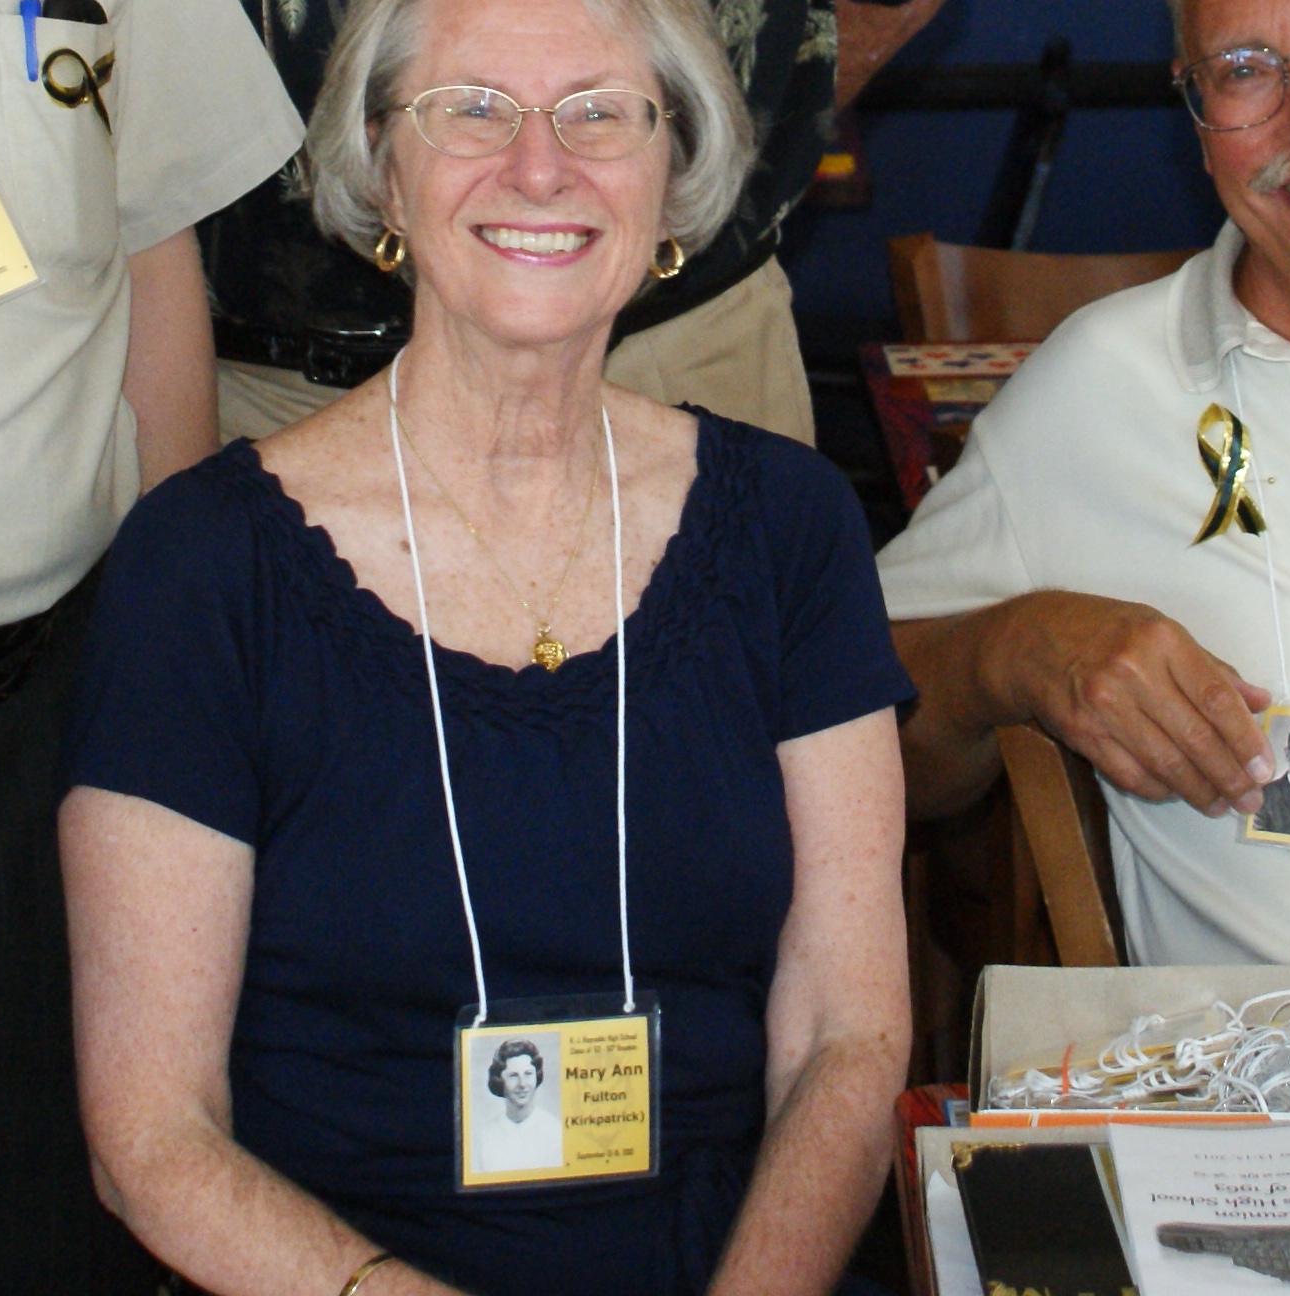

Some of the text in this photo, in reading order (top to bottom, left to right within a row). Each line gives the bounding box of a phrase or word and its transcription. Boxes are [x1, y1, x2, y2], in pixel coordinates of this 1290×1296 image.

[565, 1064, 643, 1081] Mary Ann
[583, 1091, 627, 1103] Fulton
[565, 1111, 645, 1129] (Kirkpatrick)
[1214, 1183, 1260, 1194] 1963
[1268, 1182, 1288, 1195] of
[1151, 1192, 1219, 1206] School
[1225, 1196, 1277, 1208] High
